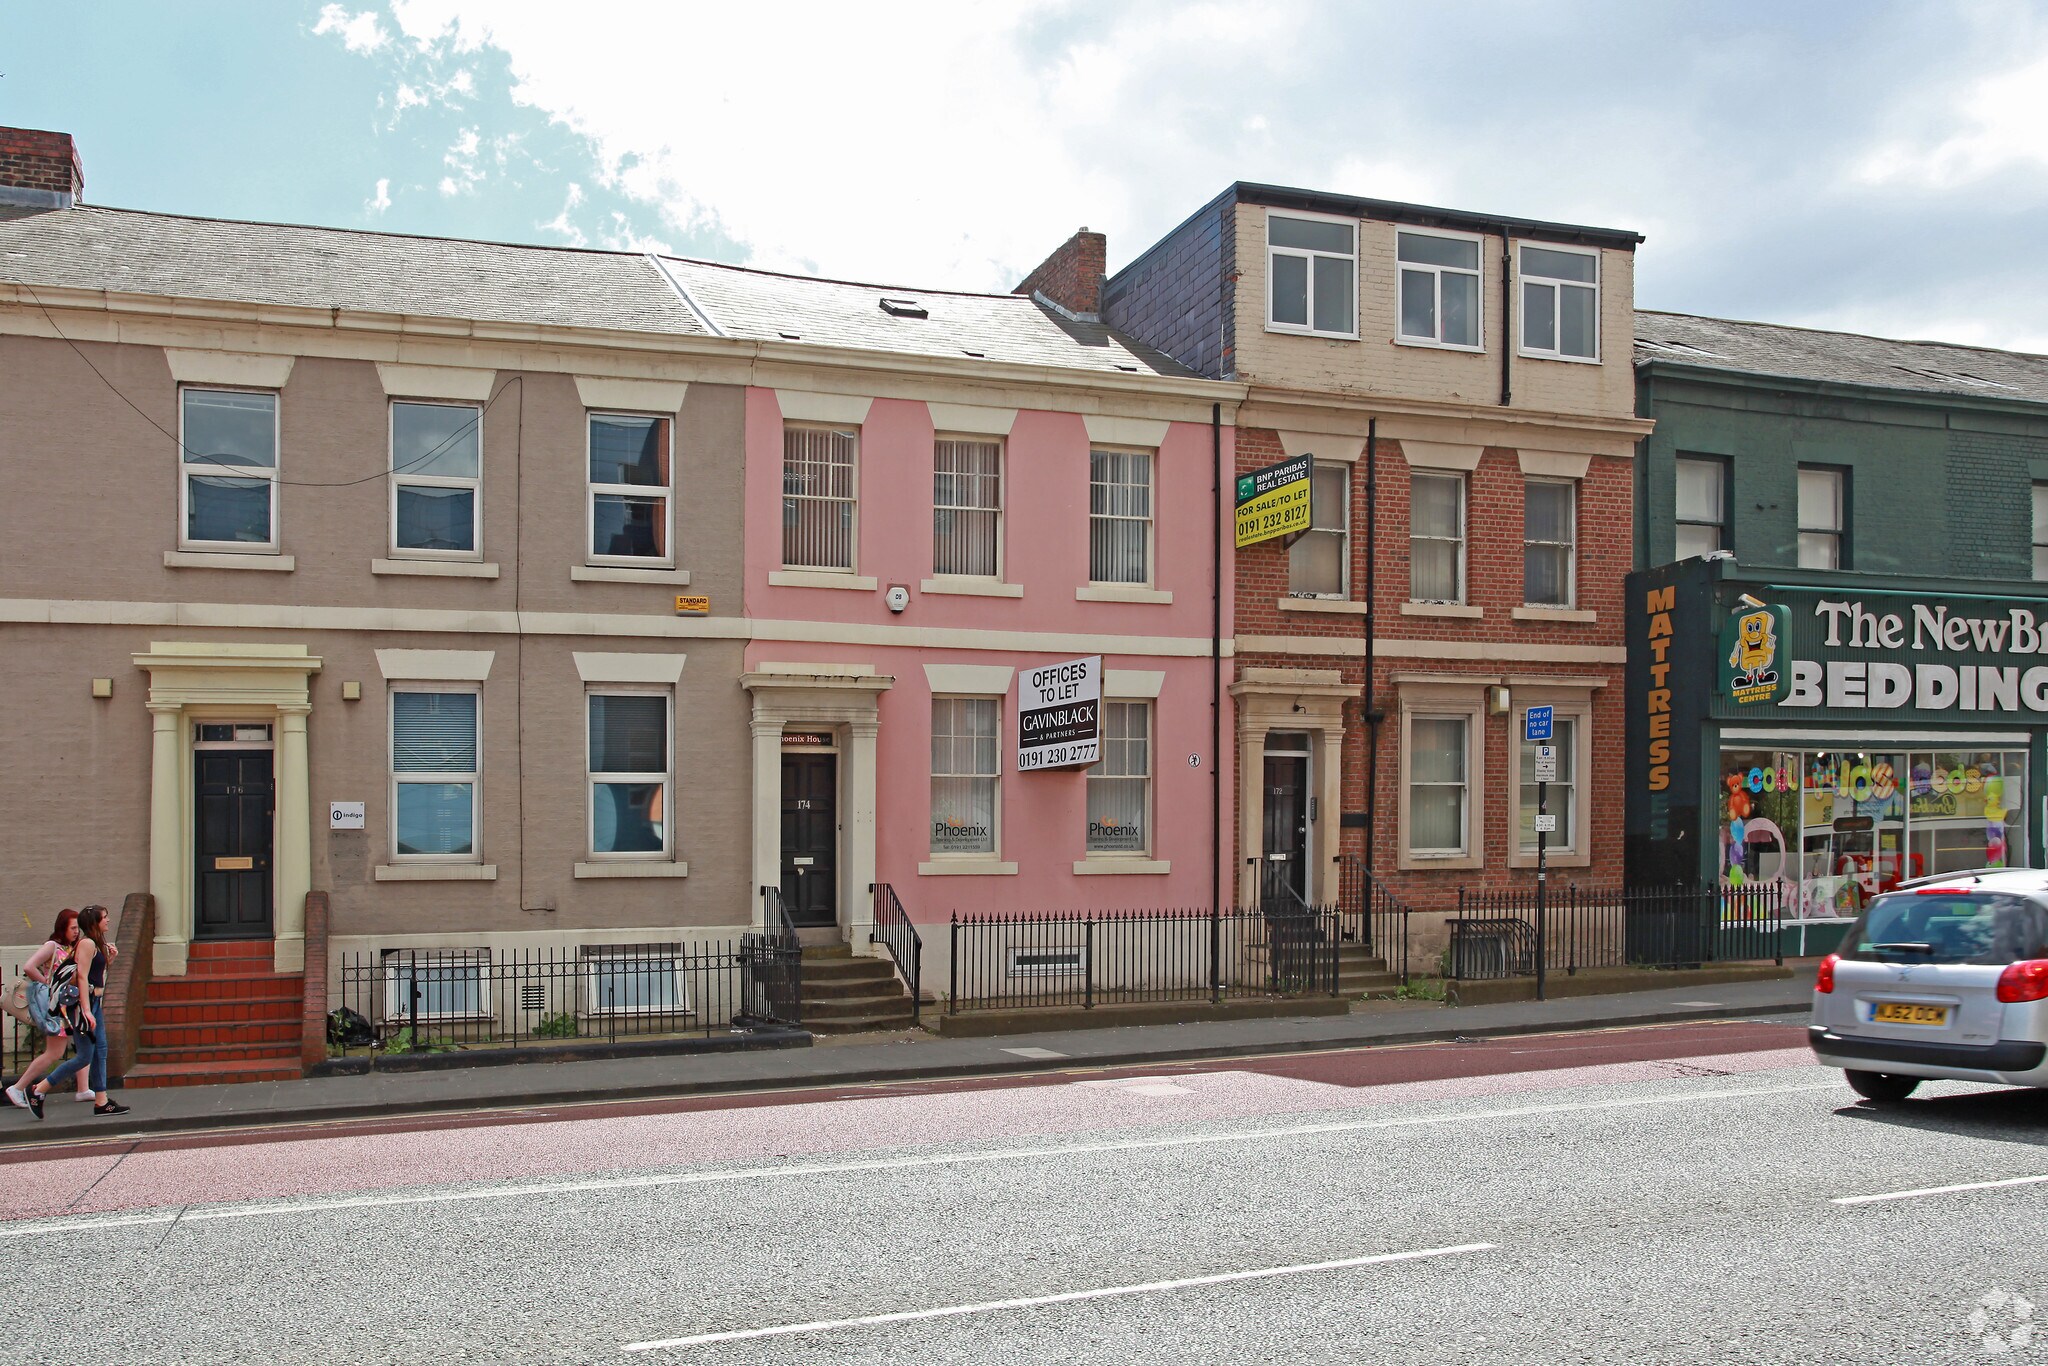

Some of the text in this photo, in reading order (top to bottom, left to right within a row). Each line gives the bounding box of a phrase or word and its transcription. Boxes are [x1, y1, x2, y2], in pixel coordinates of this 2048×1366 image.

[1256, 460, 1307, 484] BNP PARIBAS
[1256, 470, 1305, 492] REAL ESTATE
[1237, 488, 1307, 518] FOR SALE/TO LET
[1238, 503, 1307, 536] 0191 232 8127
[1815, 600, 1904, 649] The
[1032, 662, 1087, 688] OFFICES
[1039, 683, 1079, 703] TO LET
[1647, 585, 1675, 791] MATTRESS
[1732, 683, 1777, 697] MATTRESS
[1778, 660, 2048, 712] BEDDING
[1738, 692, 1771, 704] CENTRE
[1023, 705, 1094, 731] GAVINBLACK
[1529, 709, 1550, 719] End of
[1529, 719, 1549, 728] no car
[806, 735, 830, 743] House
[1045, 729, 1076, 740] PARTNERS
[1531, 728, 1546, 736] lane
[1019, 743, 1097, 768] 0191 230 2777
[226, 786, 244, 795] 176
[1273, 787, 1283, 795] 172
[797, 800, 811, 810] 174
[935, 821, 987, 837] Phoenix
[1089, 821, 1139, 836] Phoenix
